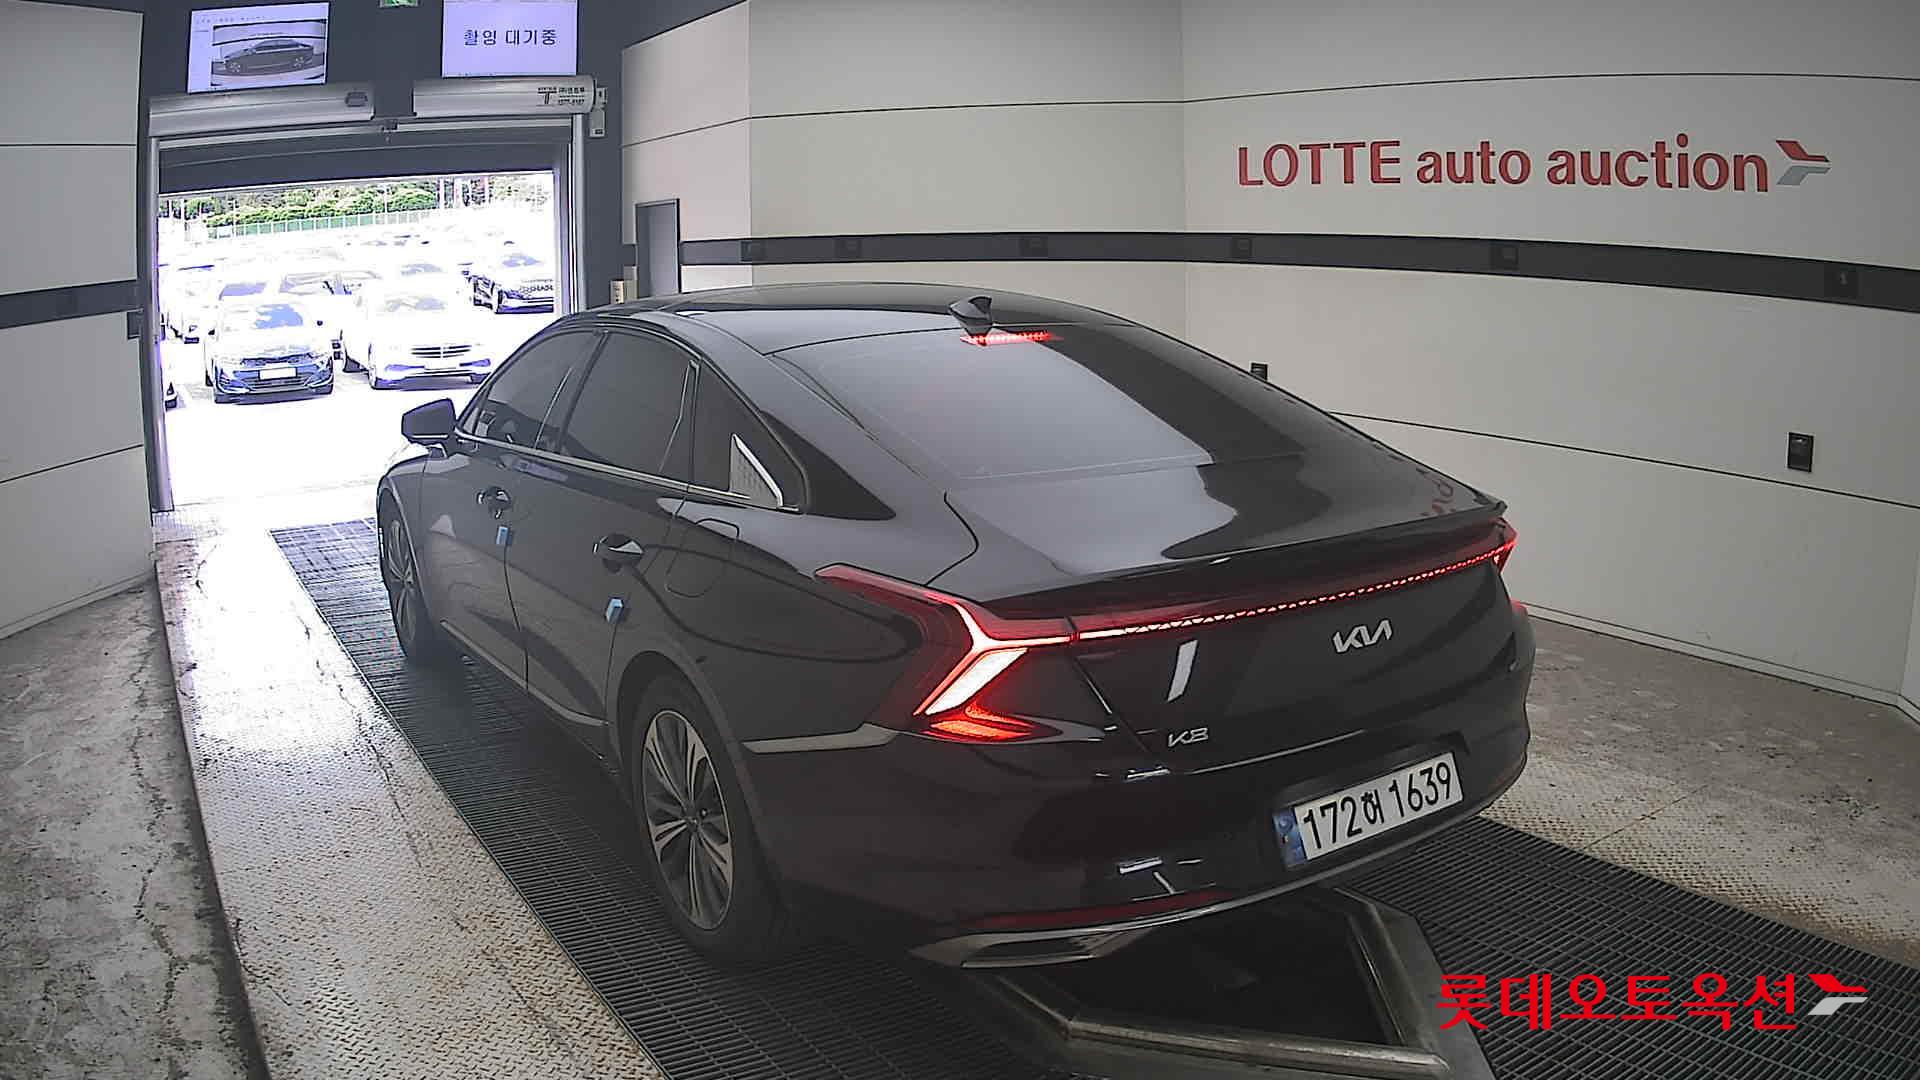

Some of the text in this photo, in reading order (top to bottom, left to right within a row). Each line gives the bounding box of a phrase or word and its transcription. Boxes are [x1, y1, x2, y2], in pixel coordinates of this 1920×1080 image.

[505, 29, 557, 46] 대기중
[1238, 132, 1769, 193] LOTTE auto auction
[1167, 726, 1210, 748] K8
[1303, 761, 1453, 851] 172허 1639
